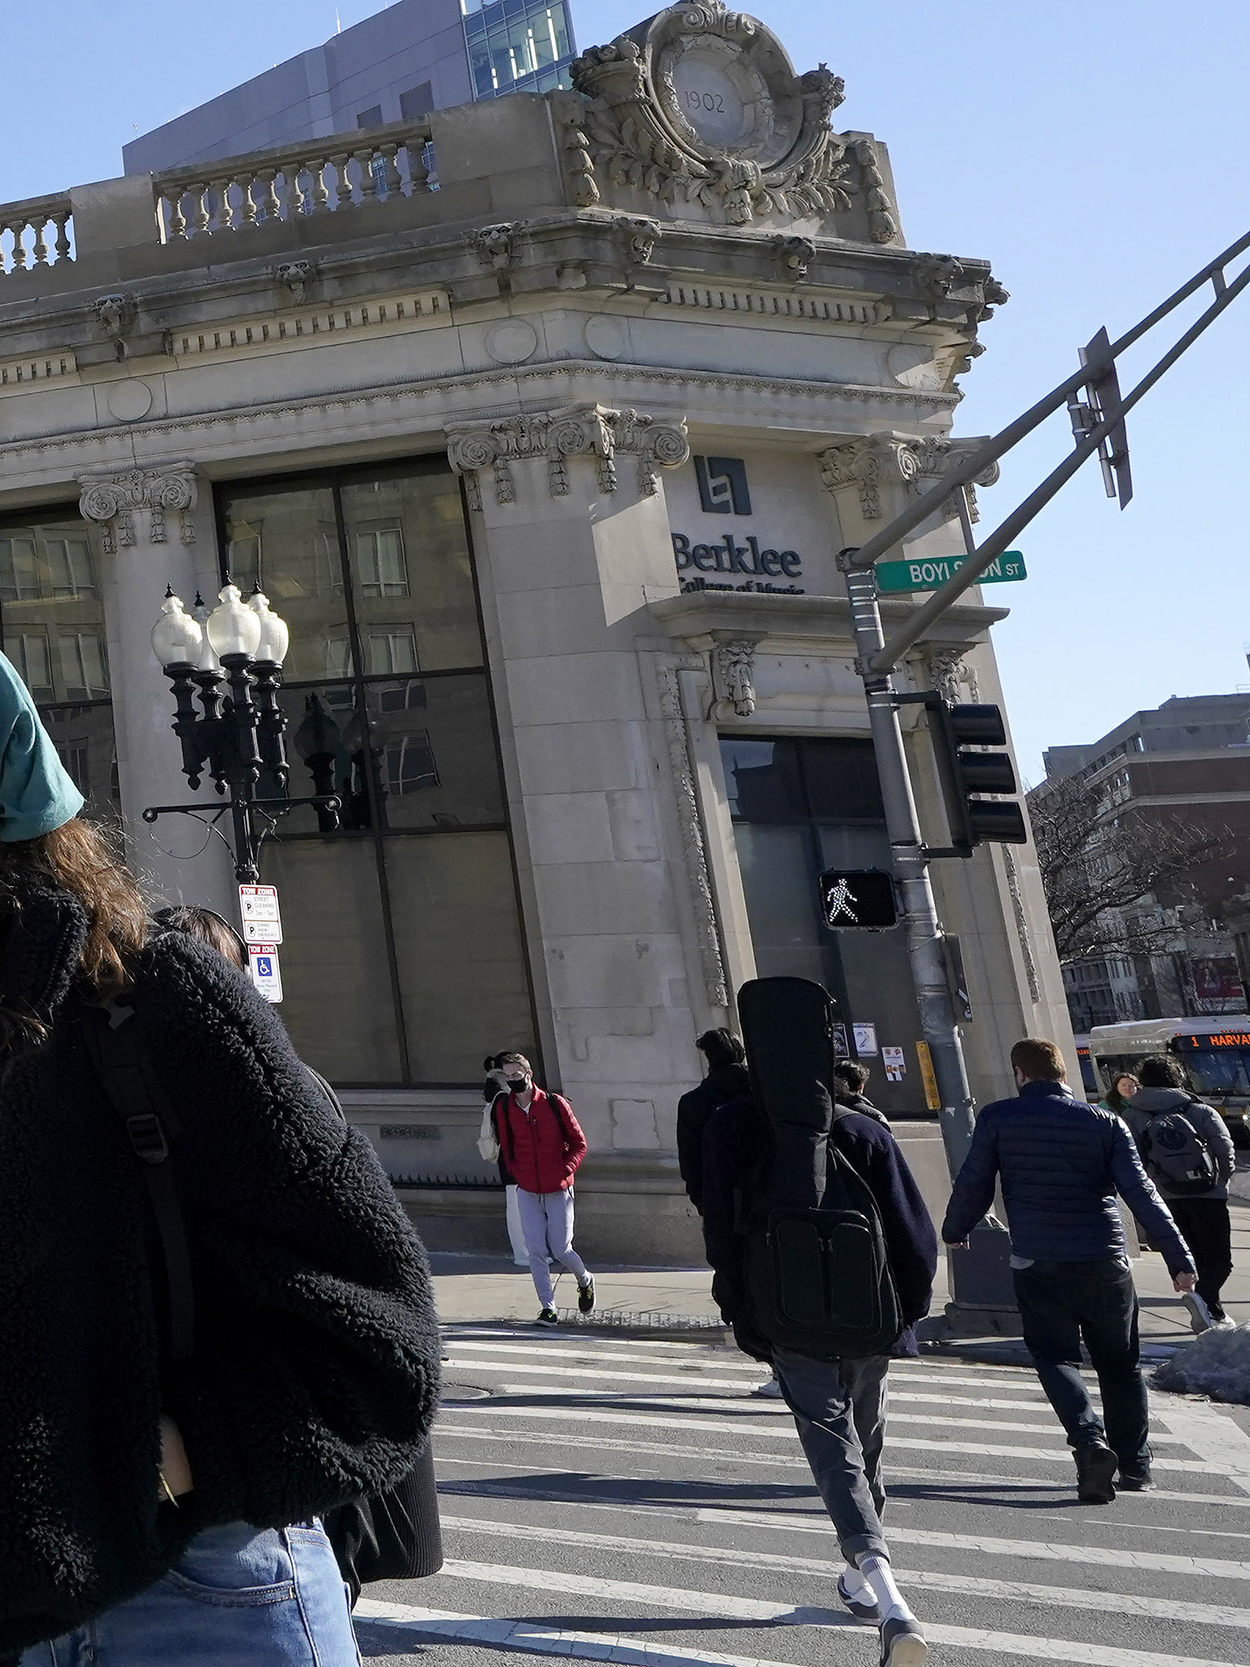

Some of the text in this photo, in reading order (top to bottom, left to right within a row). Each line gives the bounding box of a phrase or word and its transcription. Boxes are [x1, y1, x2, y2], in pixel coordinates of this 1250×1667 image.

[685, 91, 724, 113] 1902
[671, 533, 803, 577] Berklee
[910, 558, 1019, 583] BOYLN ST
[242, 887, 274, 896] TOW ZONE
[250, 945, 261, 953] TOW
[1191, 1034, 1250, 1047] 1 HARVA
